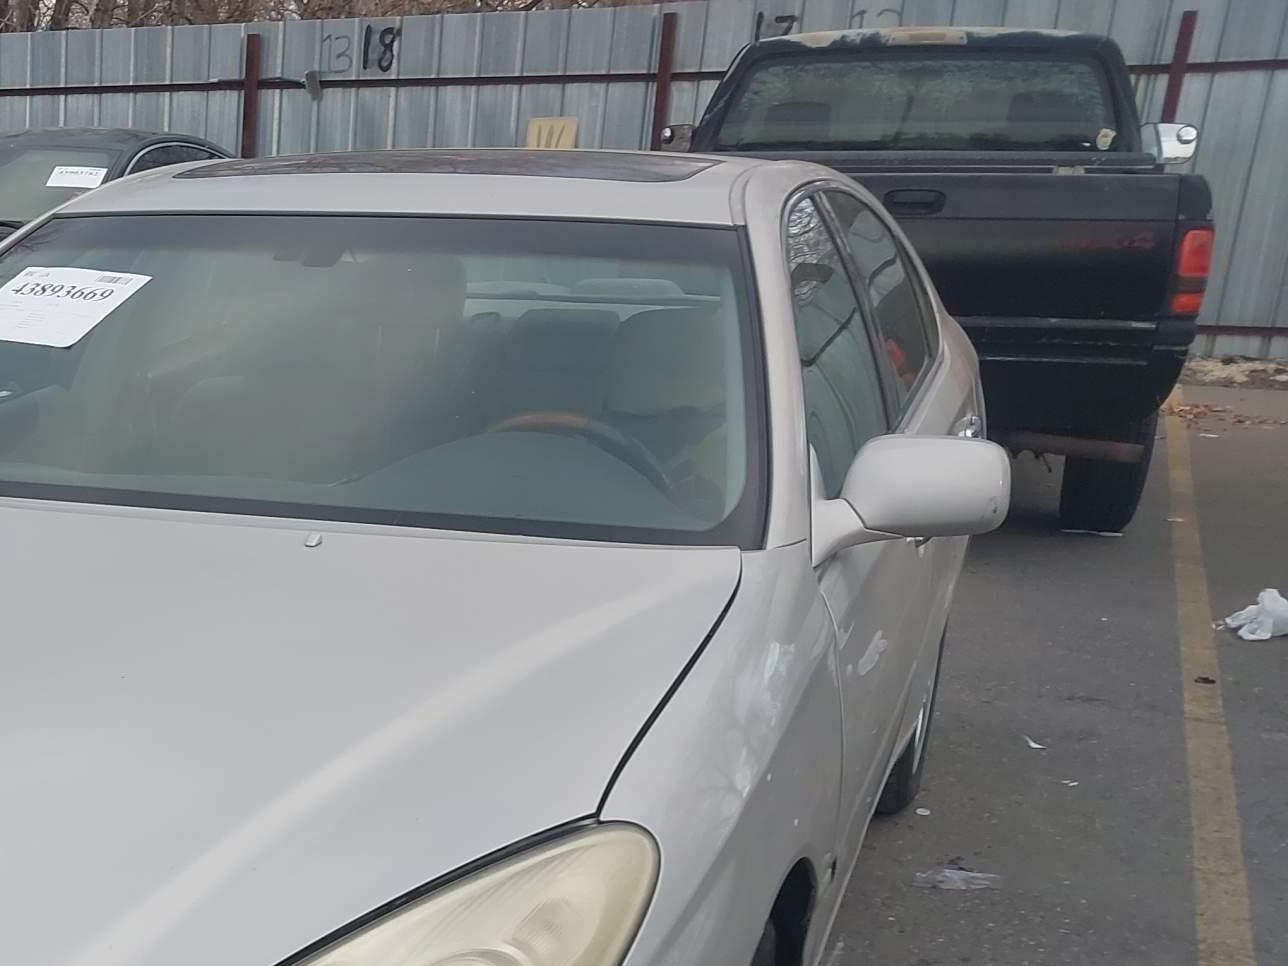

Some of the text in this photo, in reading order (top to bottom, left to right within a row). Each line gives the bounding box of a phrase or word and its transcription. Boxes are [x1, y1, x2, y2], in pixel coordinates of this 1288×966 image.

[320, 34, 353, 74] 13
[362, 24, 401, 72] 18
[11, 281, 114, 301] 43893669
